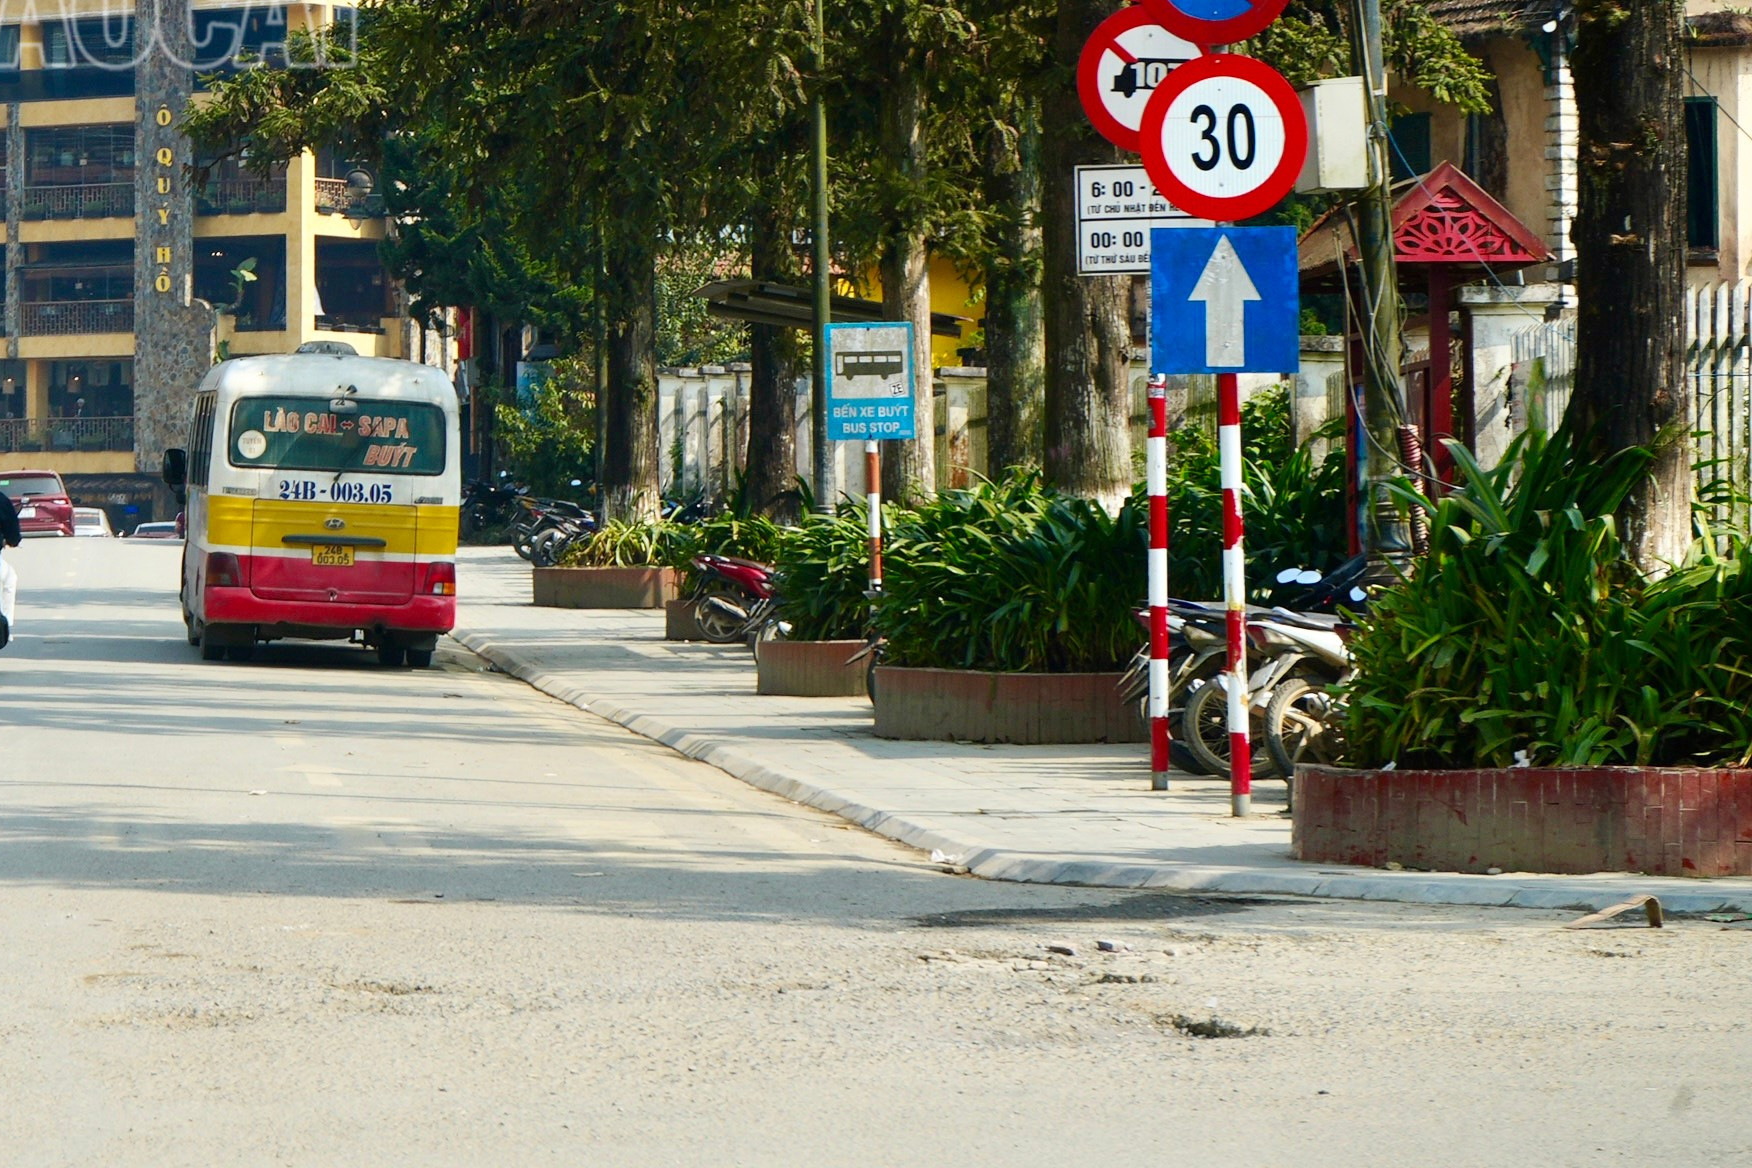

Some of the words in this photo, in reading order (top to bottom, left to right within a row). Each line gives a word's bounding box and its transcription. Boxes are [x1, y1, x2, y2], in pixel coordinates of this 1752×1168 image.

[1189, 102, 1257, 173] 30
[1113, 180, 1133, 198] 00
[1123, 231, 1144, 248] 00
[833, 400, 857, 418] BẾN
[859, 406, 875, 417] XE
[878, 402, 909, 417] BUÝT
[358, 415, 410, 439] SAPA
[842, 422, 866, 434] BUS
[869, 422, 901, 434] STOP
[363, 441, 417, 468] BUÝT
[279, 480, 316, 501] 24B
[331, 482, 393, 504] 003.05
